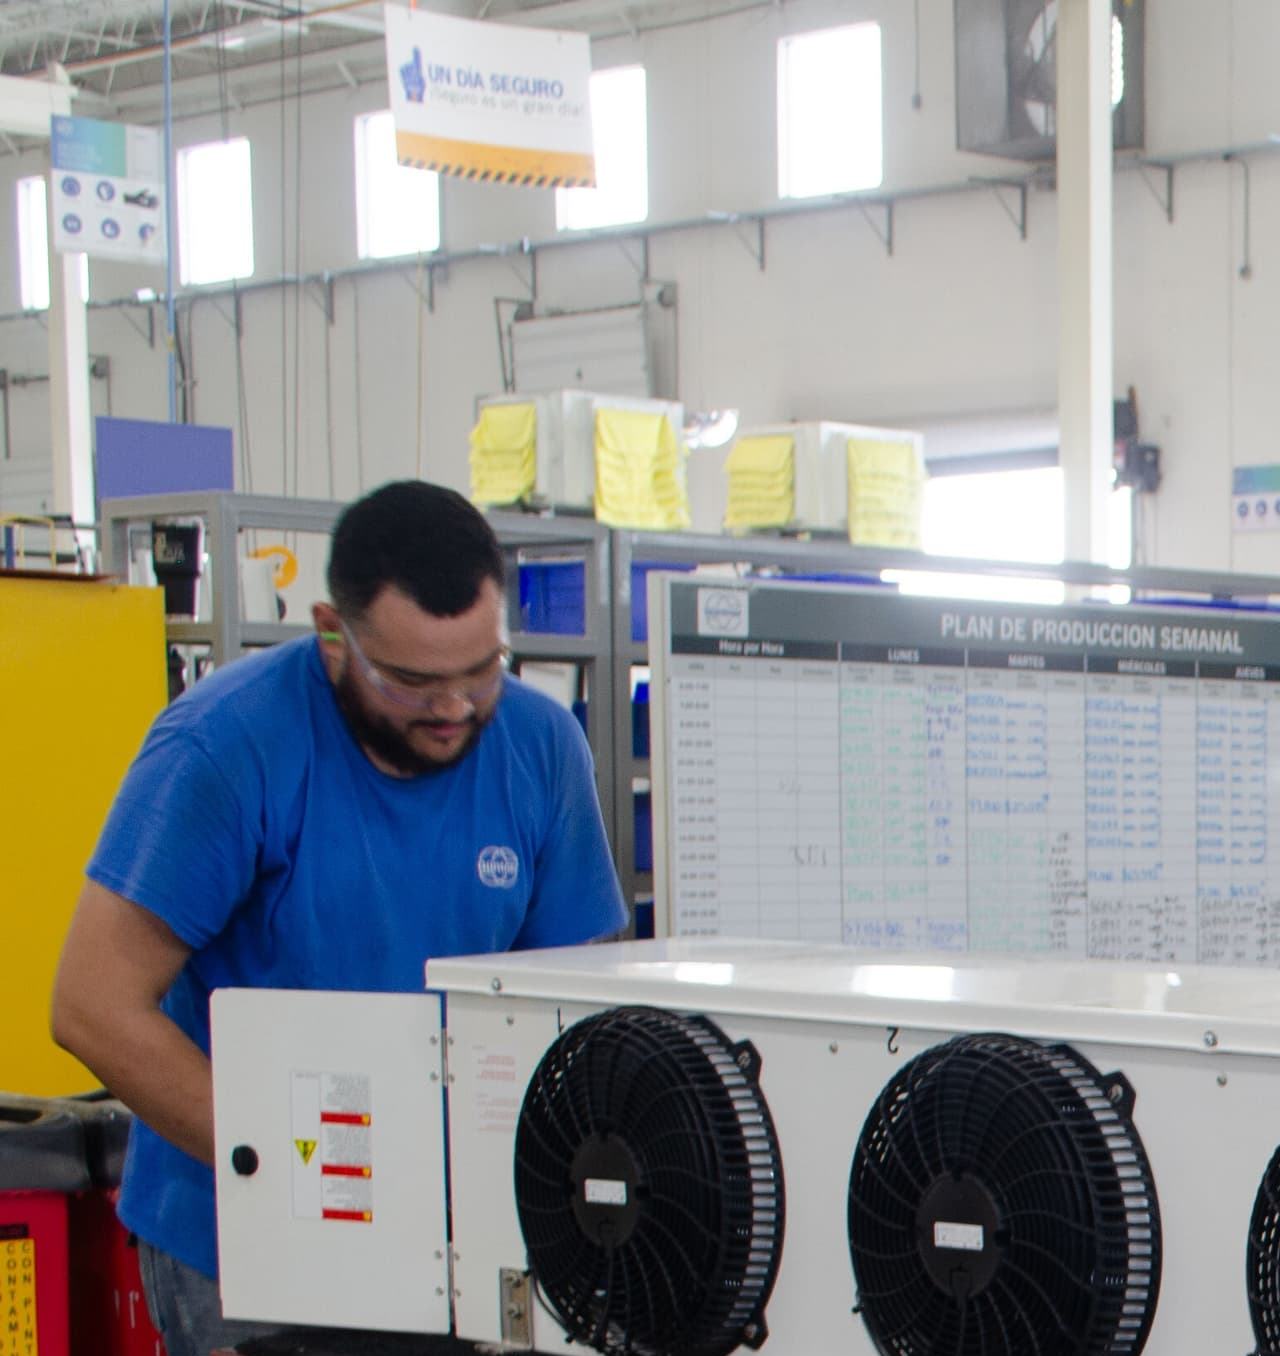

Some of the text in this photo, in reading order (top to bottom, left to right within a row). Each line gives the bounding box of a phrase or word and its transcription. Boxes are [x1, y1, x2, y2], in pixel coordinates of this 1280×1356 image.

[428, 64, 451, 85] UN
[490, 74, 564, 100] SEGURO
[941, 613, 1244, 654] PLAN DE PRODUCCION SEMANAL
[888, 648, 919, 663] LUNES
[1008, 654, 1045, 670] MARTES
[886, 1025, 899, 1054] 2
[21, 1240, 32, 1283] CON
